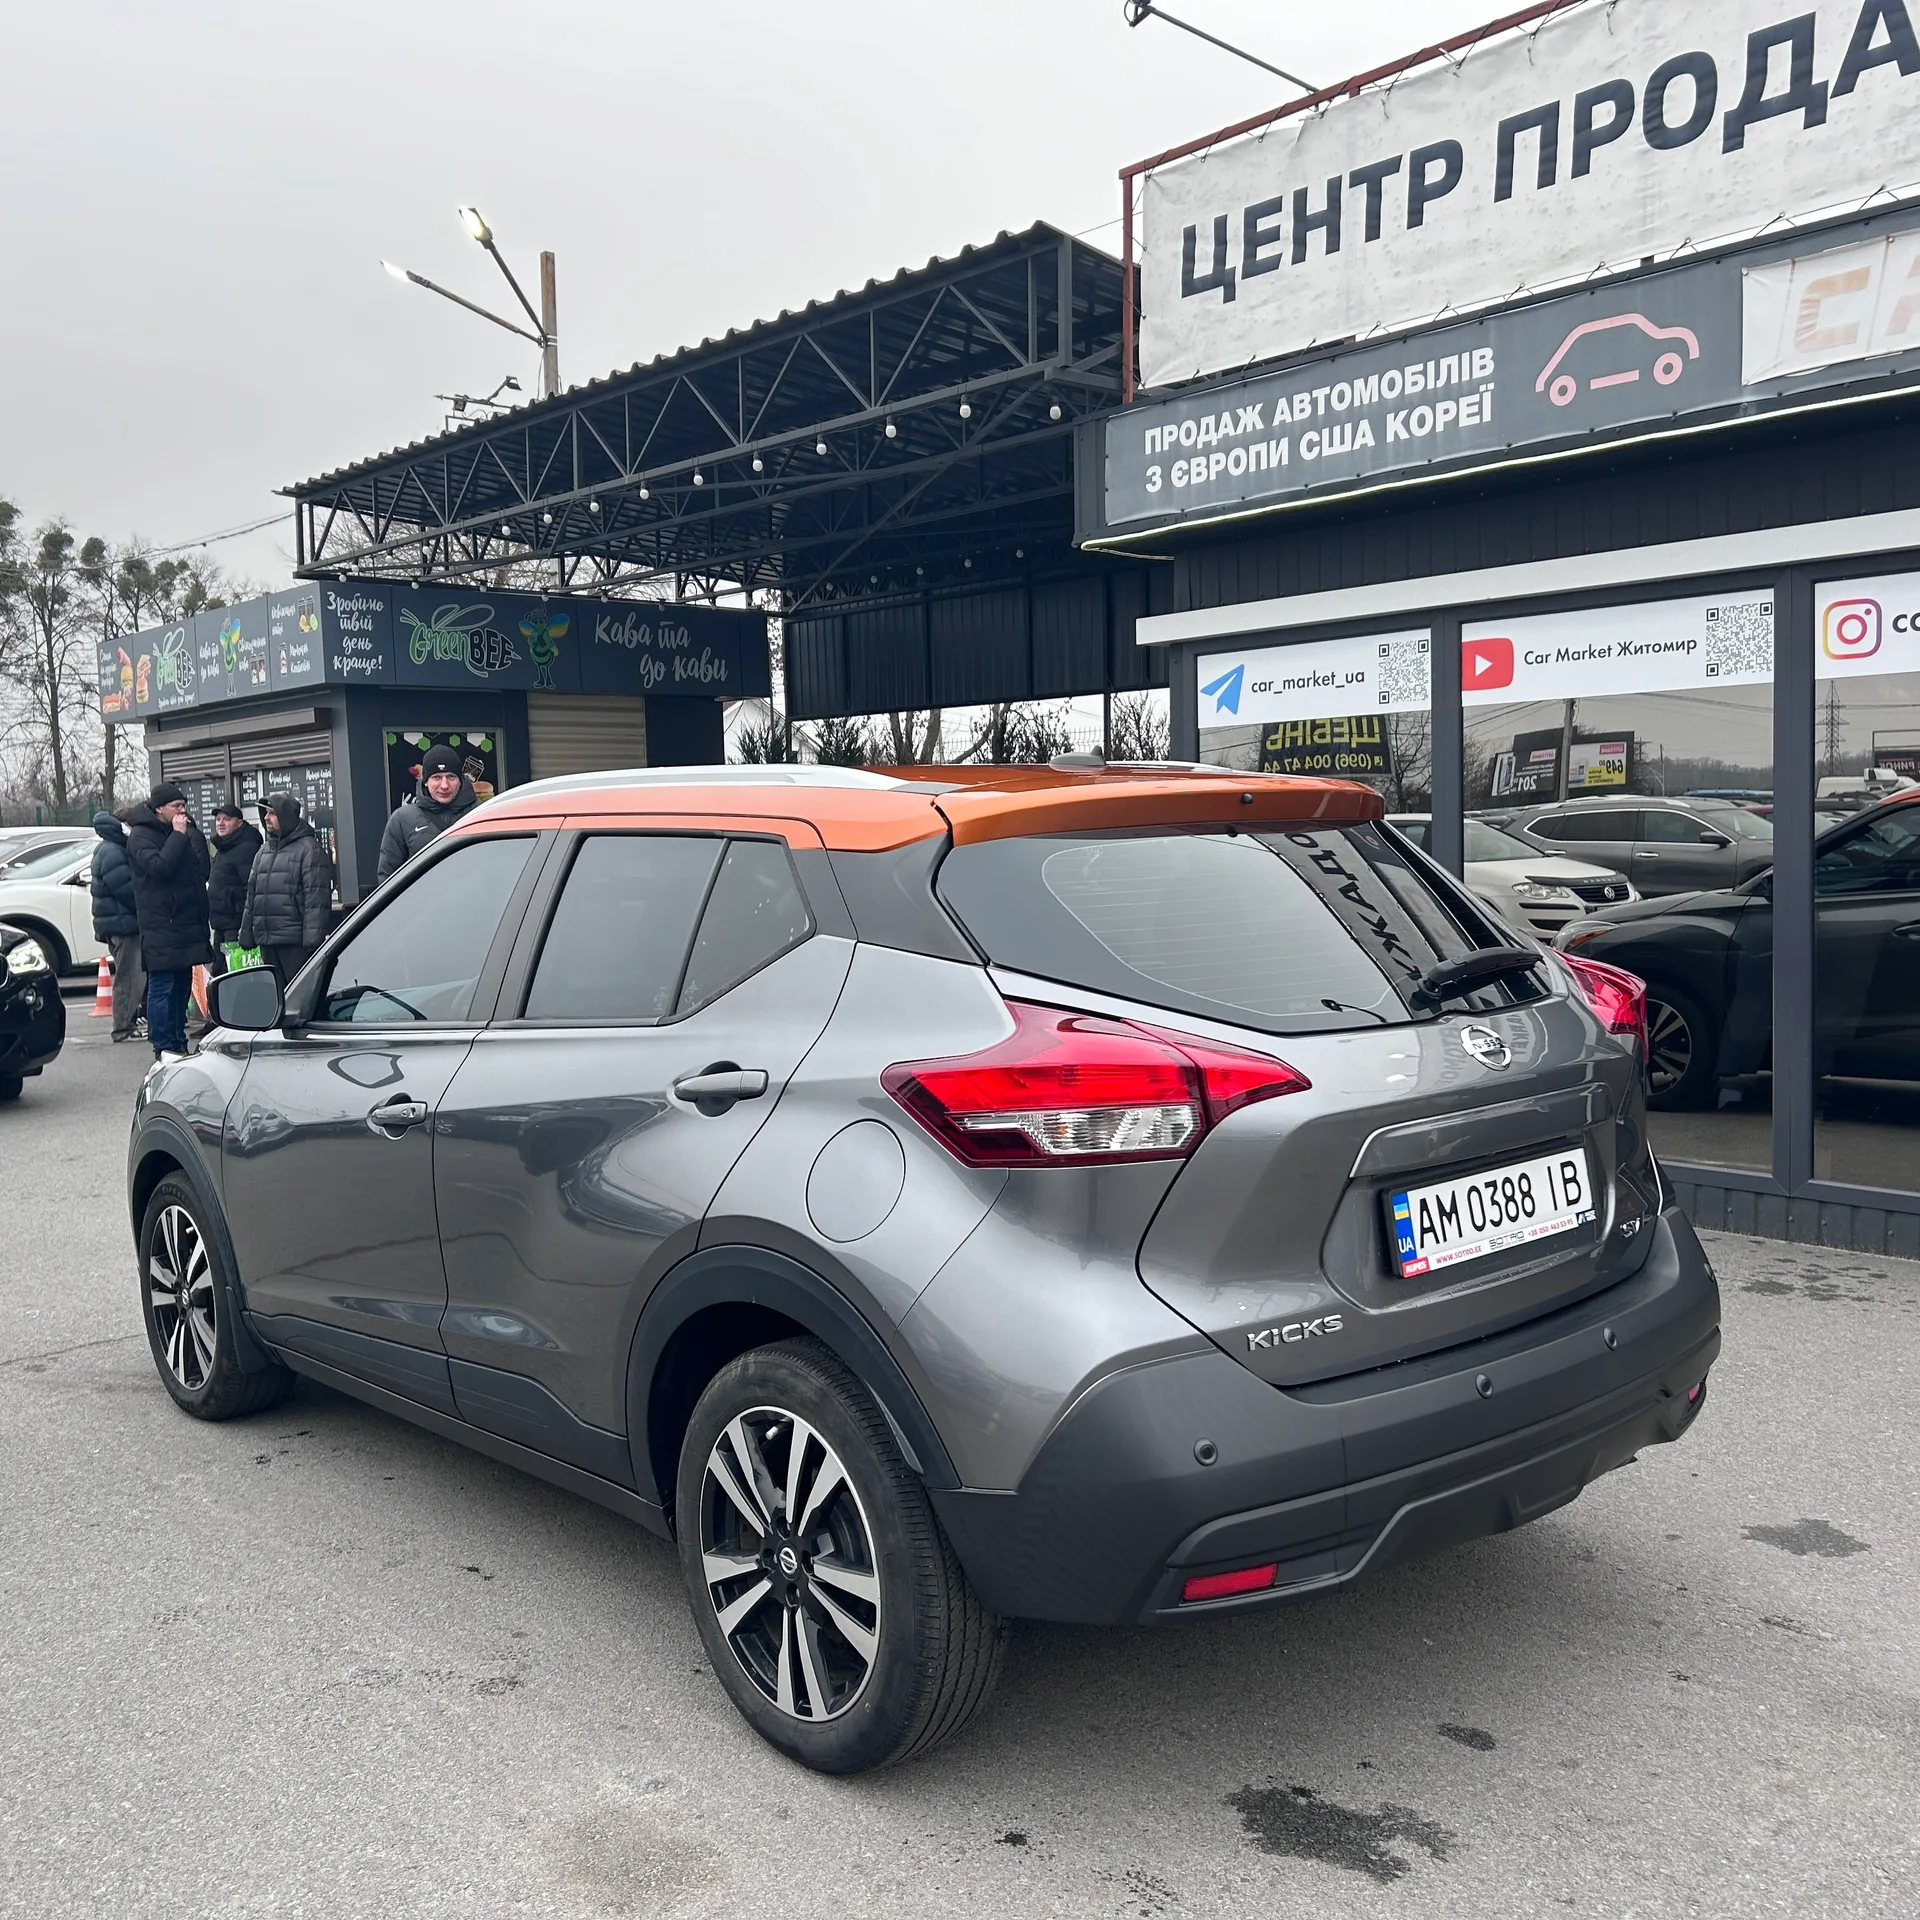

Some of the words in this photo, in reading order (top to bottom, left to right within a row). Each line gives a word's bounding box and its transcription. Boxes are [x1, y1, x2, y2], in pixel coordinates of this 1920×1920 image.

[1181, 138, 1463, 304] ЦЕНТР
[1145, 403, 1265, 454] ПРОДАЖ
[1272, 347, 1494, 426] АВТОМОБІЛІВ
[1170, 437, 1289, 488] ЄВРОПИ
[1300, 418, 1375, 461] США
[1386, 383, 1495, 442] КОРЕЇ
[326, 591, 384, 616] Зробимо
[340, 612, 374, 632] твій
[595, 611, 653, 649] Кава
[658, 621, 691, 649] та
[342, 636, 373, 655] день
[1524, 651, 1551, 665] Car
[1555, 644, 1612, 662] Market
[1617, 639, 1697, 656] Житомир
[333, 655, 383, 677] краще!
[639, 653, 666, 688] до
[672, 647, 728, 683] кави
[1251, 670, 1365, 694] car_market_ua
[1420, 1190, 1463, 1249] AM
[1467, 1173, 1536, 1232] 0388
[1547, 1160, 1582, 1212] IB
[1398, 1238, 1415, 1254] UA
[1246, 1314, 1344, 1351] KICKS
